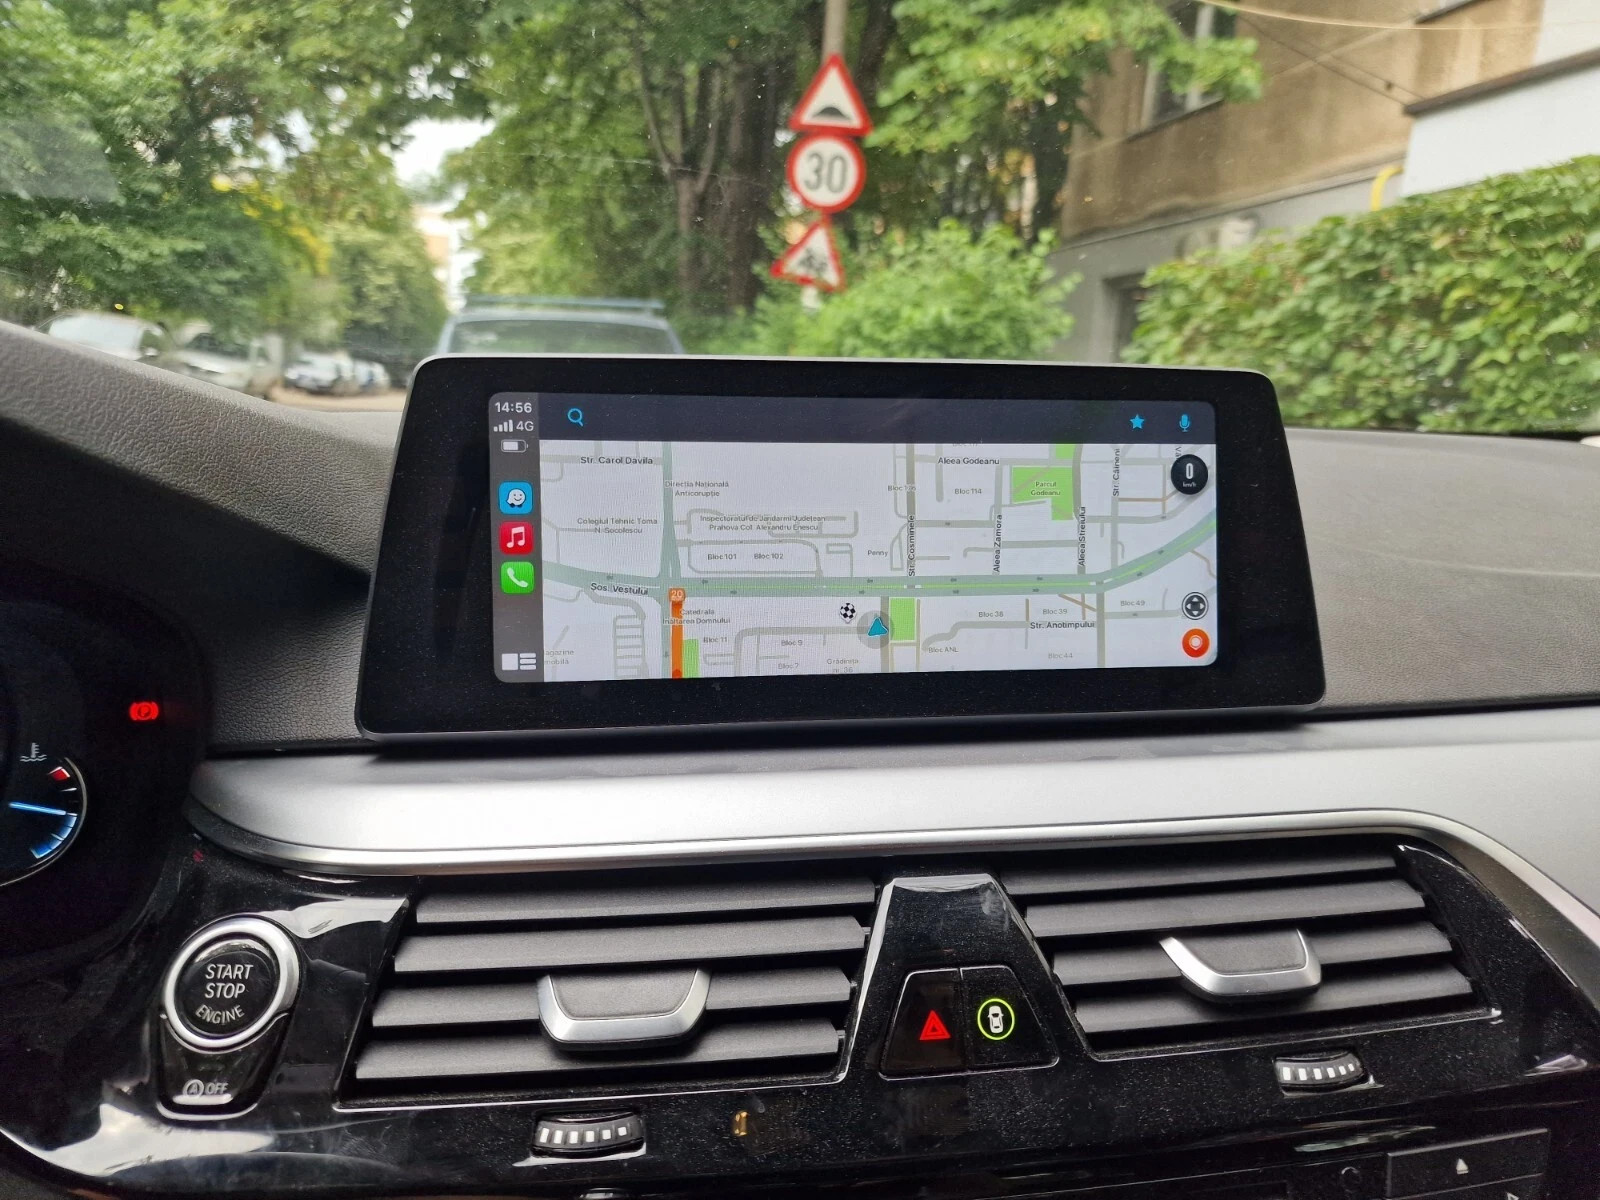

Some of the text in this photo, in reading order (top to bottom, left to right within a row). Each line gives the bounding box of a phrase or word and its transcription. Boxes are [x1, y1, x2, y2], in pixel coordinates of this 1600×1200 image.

[803, 153, 847, 194] 30
[494, 402, 533, 414] 14:56
[516, 421, 534, 432] 4G
[598, 456, 623, 465] Carol
[625, 456, 653, 465] Davila
[938, 457, 1000, 465] Aleea Godeanu
[1186, 462, 1194, 480] 0
[993, 514, 1003, 573] Aleea Zamora
[708, 553, 723, 561] Bloc
[1078, 541, 1086, 567] Aleea
[612, 584, 649, 596] Vestului
[1030, 621, 1095, 629] Str. Anotimpului
[205, 964, 253, 980] START
[204, 982, 246, 999] STOP
[195, 1004, 245, 1025] ENGINE
[206, 1082, 228, 1094] OFF
